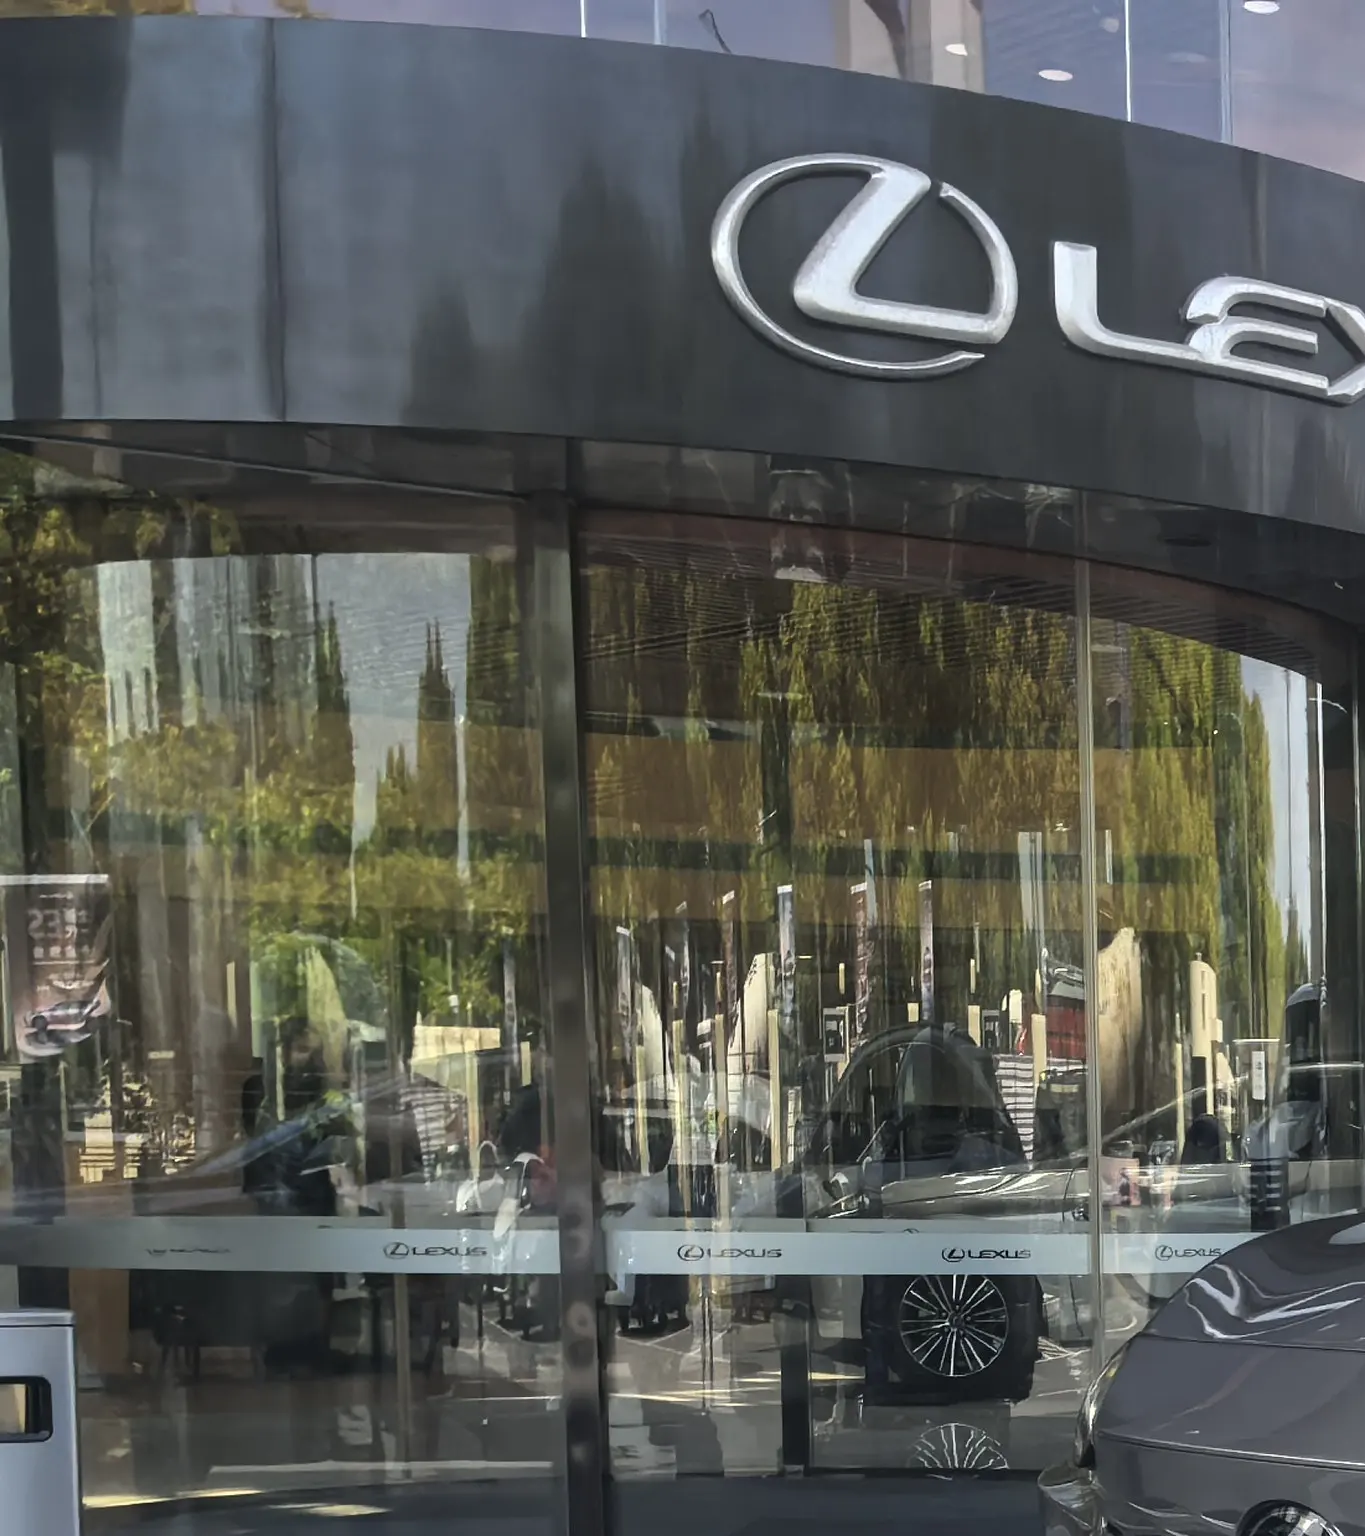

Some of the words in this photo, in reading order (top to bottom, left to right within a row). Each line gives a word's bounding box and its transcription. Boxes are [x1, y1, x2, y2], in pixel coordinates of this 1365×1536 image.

[412, 1246, 487, 1257] LEXUS
[707, 1247, 783, 1259] LEXUS
[967, 1247, 1032, 1260] LEXUS
[1173, 1247, 1223, 1258] LEXUS
